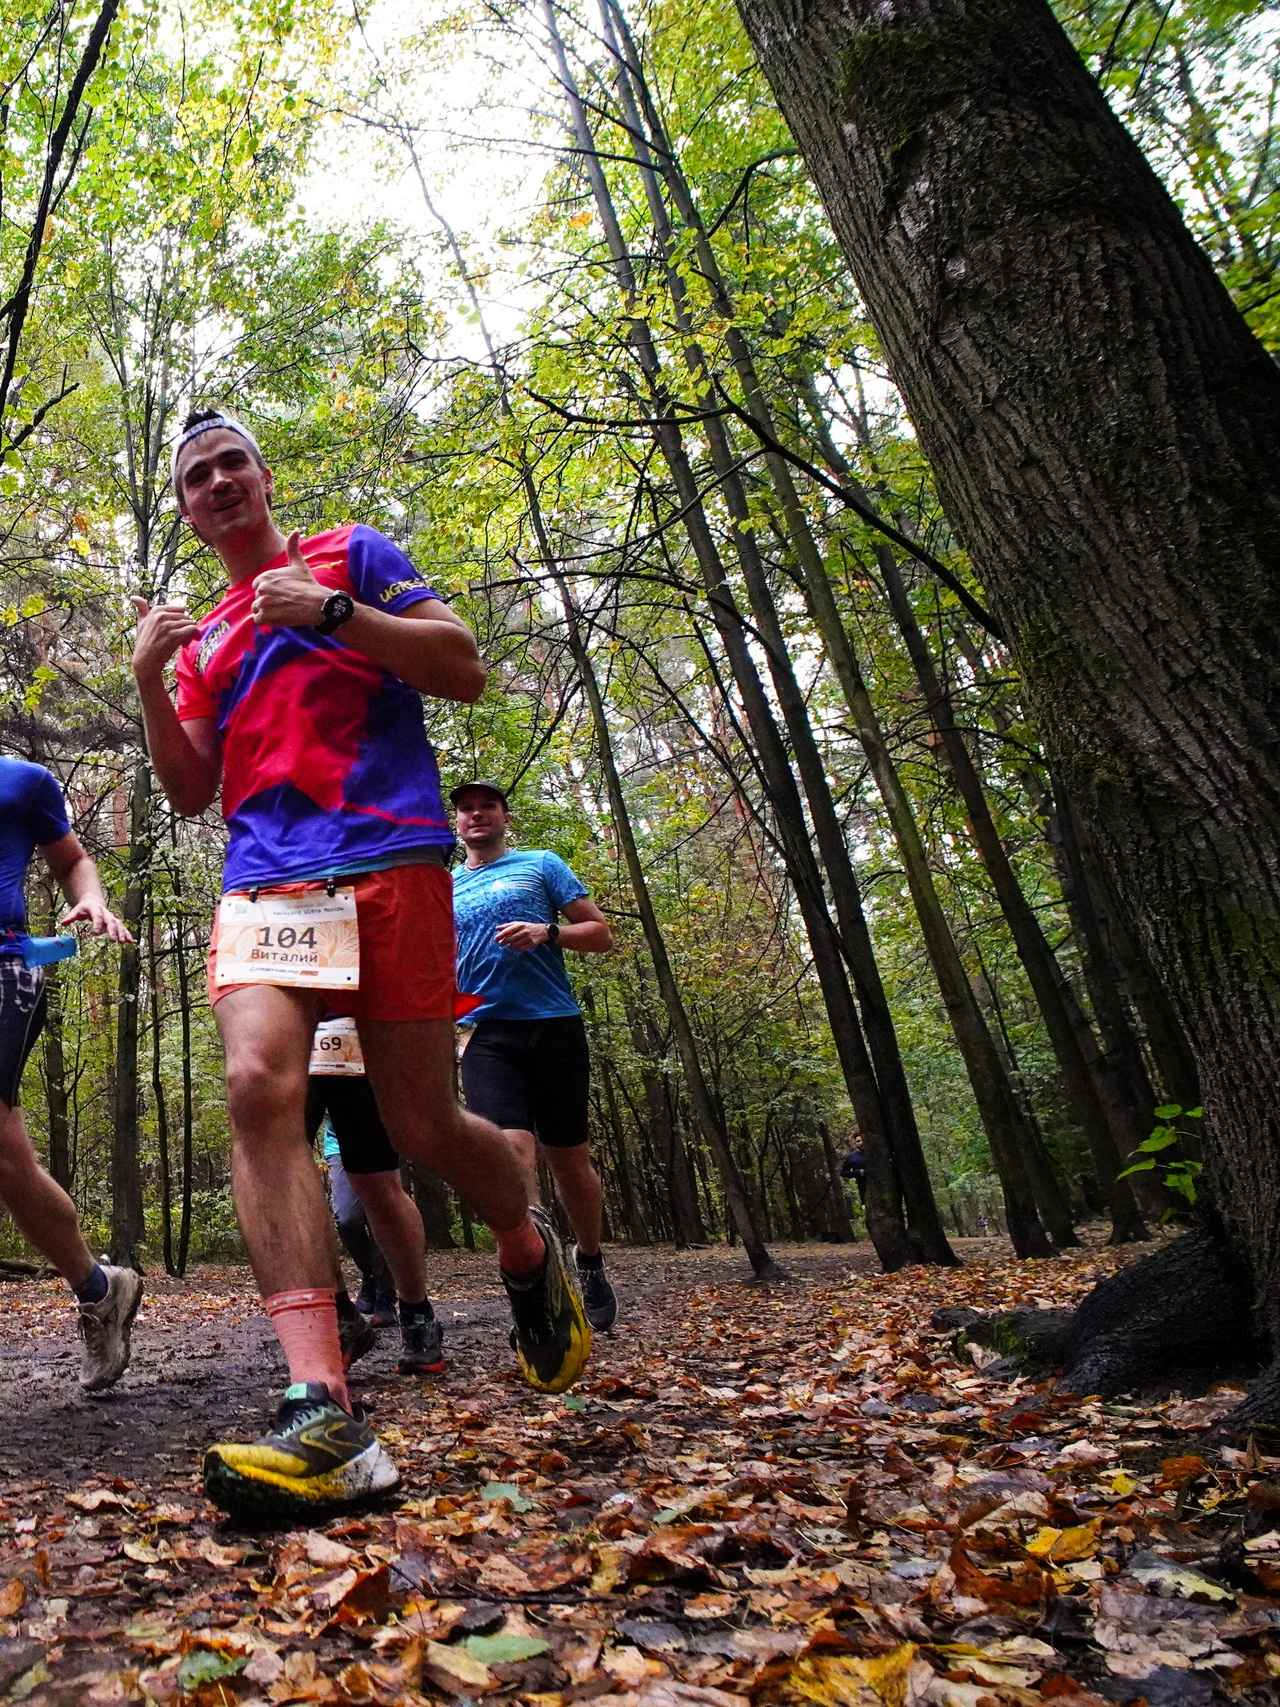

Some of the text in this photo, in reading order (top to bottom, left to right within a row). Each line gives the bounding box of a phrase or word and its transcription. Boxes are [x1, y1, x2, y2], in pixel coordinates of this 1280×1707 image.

[257, 926, 318, 949] 104
[251, 949, 319, 963] Виталий
[312, 1036, 342, 1050] 69
